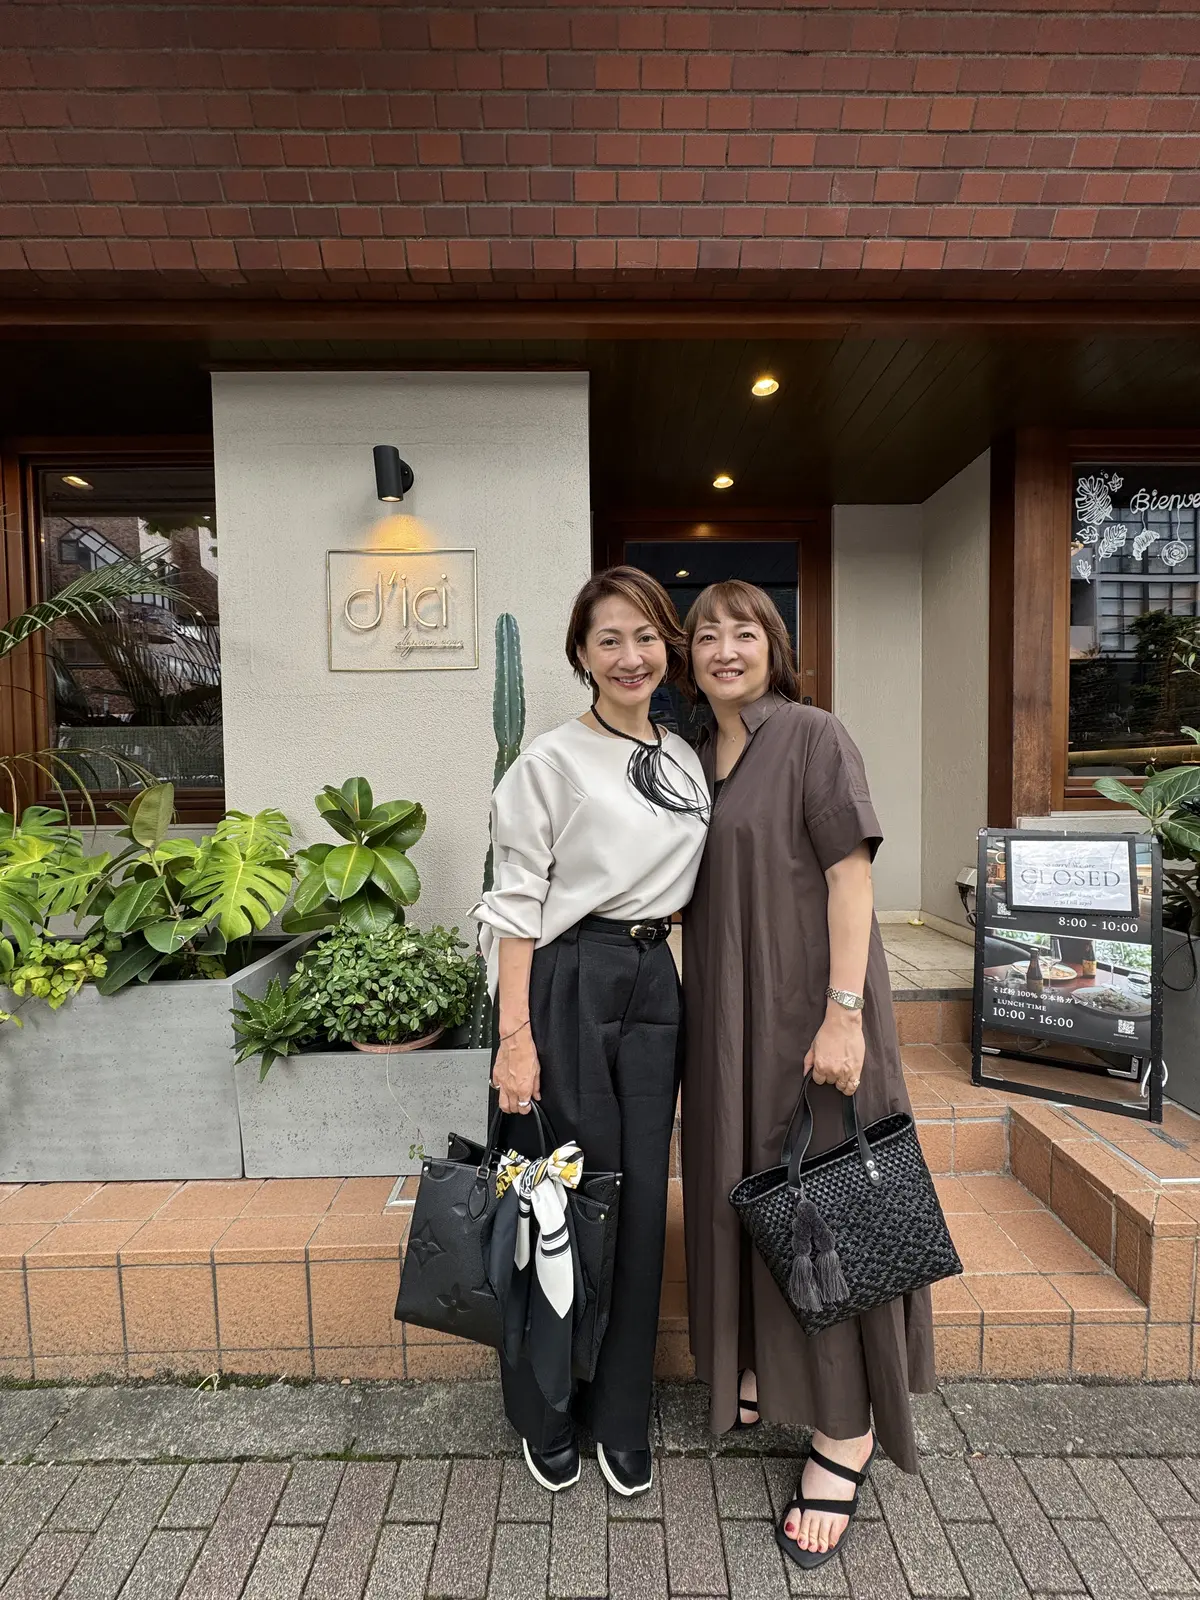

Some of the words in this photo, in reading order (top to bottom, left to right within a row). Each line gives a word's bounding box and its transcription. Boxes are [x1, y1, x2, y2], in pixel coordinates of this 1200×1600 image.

[1020, 868, 1121, 887] CLOSED
[1058, 916, 1087, 928] 8:00
[1101, 920, 1139, 933] 10:00
[992, 986, 1016, 997] そば粉
[1017, 990, 1038, 999] 100%
[997, 998, 1025, 1009] LUNCH
[1026, 1002, 1047, 1012] TIME
[992, 1007, 1026, 1021] 10:00
[1039, 1015, 1074, 1029] 16:00
